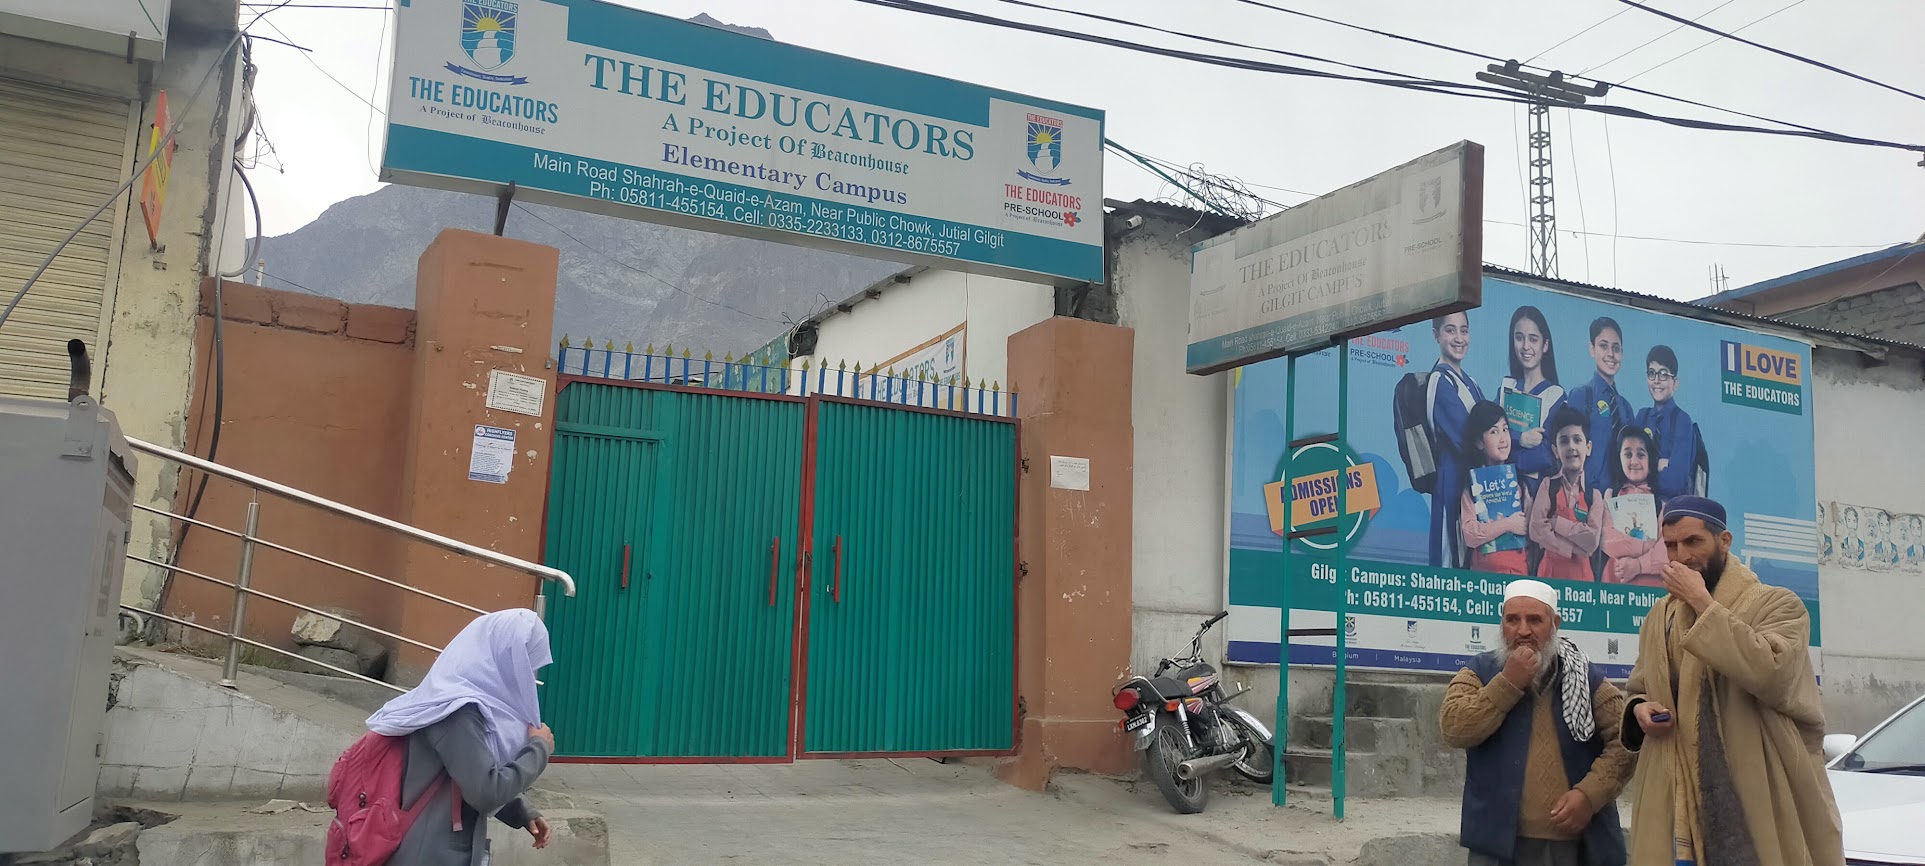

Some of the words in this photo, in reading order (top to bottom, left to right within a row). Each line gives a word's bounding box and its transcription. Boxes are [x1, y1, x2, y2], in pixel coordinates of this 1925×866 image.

[409, 76, 445, 103] THE
[451, 84, 559, 124] EDUCATORS
[584, 53, 687, 106] THE
[702, 78, 975, 161] EDUCATORS
[420, 105, 427, 113] A
[430, 106, 464, 119] Project
[482, 114, 546, 135] Beaconhouse
[1037, 117, 1063, 128] EDUCATORS
[661, 113, 680, 132] A
[688, 116, 772, 150] Project
[779, 135, 807, 156] Of
[811, 141, 909, 174] Beaconhouse
[662, 142, 807, 190] Elementary
[816, 172, 907, 205] Campus
[533, 152, 572, 174] Main
[577, 160, 617, 182] Road
[622, 168, 806, 217] Shahrah-e-Quaid-e-Azam,
[811, 203, 843, 221] Near
[846, 208, 886, 228] Public
[889, 215, 935, 237] Chowk,
[938, 224, 970, 242] Jutial
[974, 229, 1005, 250] Gilgit
[1004, 202, 1064, 221] PRE-SCHOOL
[1005, 184, 1022, 199] THE
[1026, 187, 1082, 210] EDUCATORS
[590, 181, 615, 199] Ph:
[620, 186, 728, 221] 05811-455154,
[733, 206, 764, 225] Cell:
[768, 212, 867, 243] 0335-2233133,
[871, 229, 960, 256] 0312-8675557
[1239, 257, 1274, 284] THE
[1279, 219, 1392, 272] EDUCATORS
[1404, 238, 1442, 254] PRE-SCHOOL
[1258, 287, 1265, 297] A
[1267, 279, 1295, 295] Project
[1297, 271, 1308, 285] Of
[1311, 256, 1367, 281] Beaconhouse
[1261, 289, 1305, 314] GILGIT
[1307, 273, 1362, 301] CAMPUS
[1350, 348, 1396, 362] PRE-SCHOOL
[1367, 335, 1409, 353] EDUCATORS
[1727, 343, 1735, 371] I
[1745, 350, 1797, 379] LOVE
[1724, 381, 1742, 397] THE
[1745, 384, 1800, 407] EDUCATORS
[1483, 479, 1506, 492] Let's
[1311, 563, 1347, 584] Gilg
[1351, 566, 1406, 588] Campus:
[1565, 586, 1596, 605] Road,
[1600, 589, 1625, 605] Near
[1345, 589, 1359, 605] h:
[1363, 590, 1462, 616] 05811-455154,
[1466, 598, 1494, 616] Cell:
[1394, 655, 1422, 664] Malaysia
